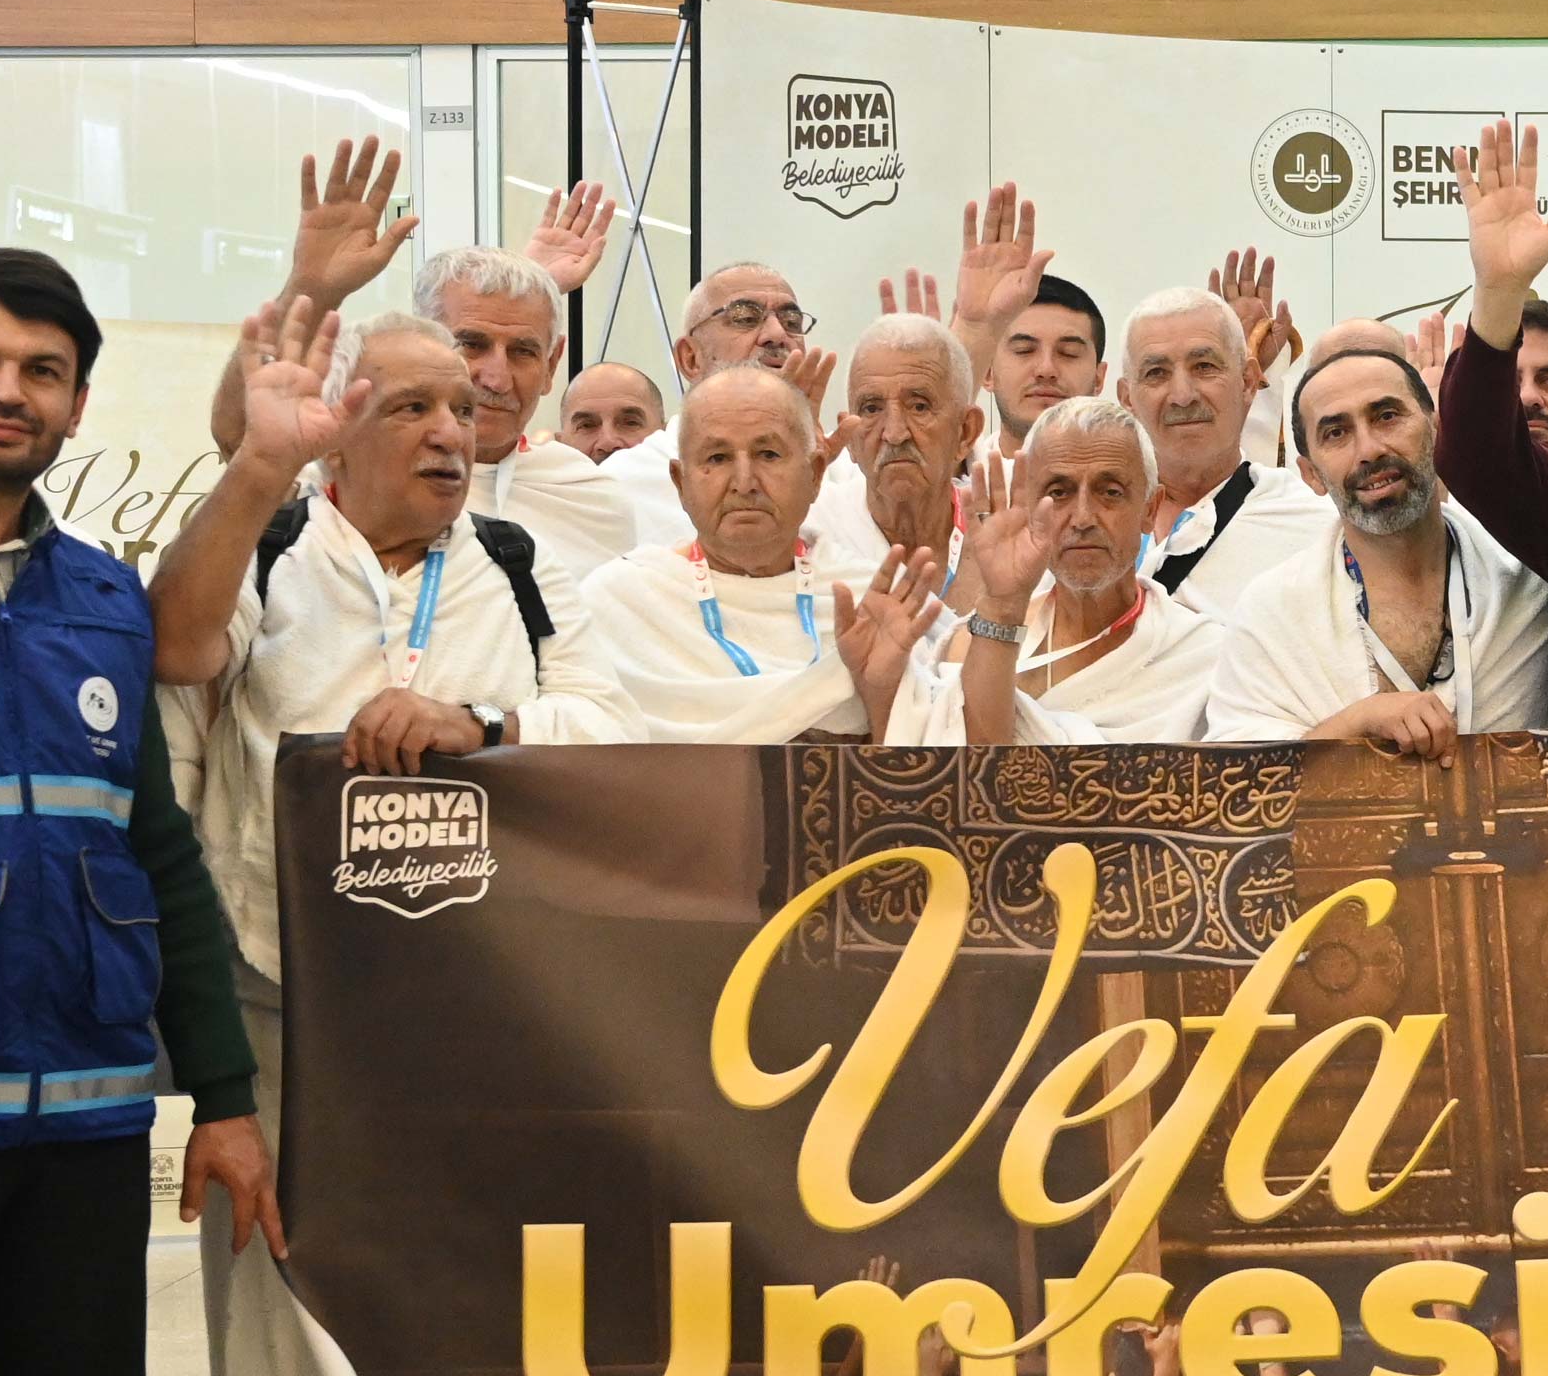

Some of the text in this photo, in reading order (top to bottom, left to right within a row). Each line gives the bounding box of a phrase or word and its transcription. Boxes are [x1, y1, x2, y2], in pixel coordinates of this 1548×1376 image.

[429, 111, 465, 124] Z-133
[795, 93, 889, 121] KONYA
[1392, 145, 1479, 174] BEN
[781, 153, 905, 199] Belediyecilik
[1392, 180, 1464, 208] ŞEHR
[352, 791, 479, 823] KONYA
[332, 849, 499, 898] Belediyecilik
[709, 841, 1460, 1360] Vefa
